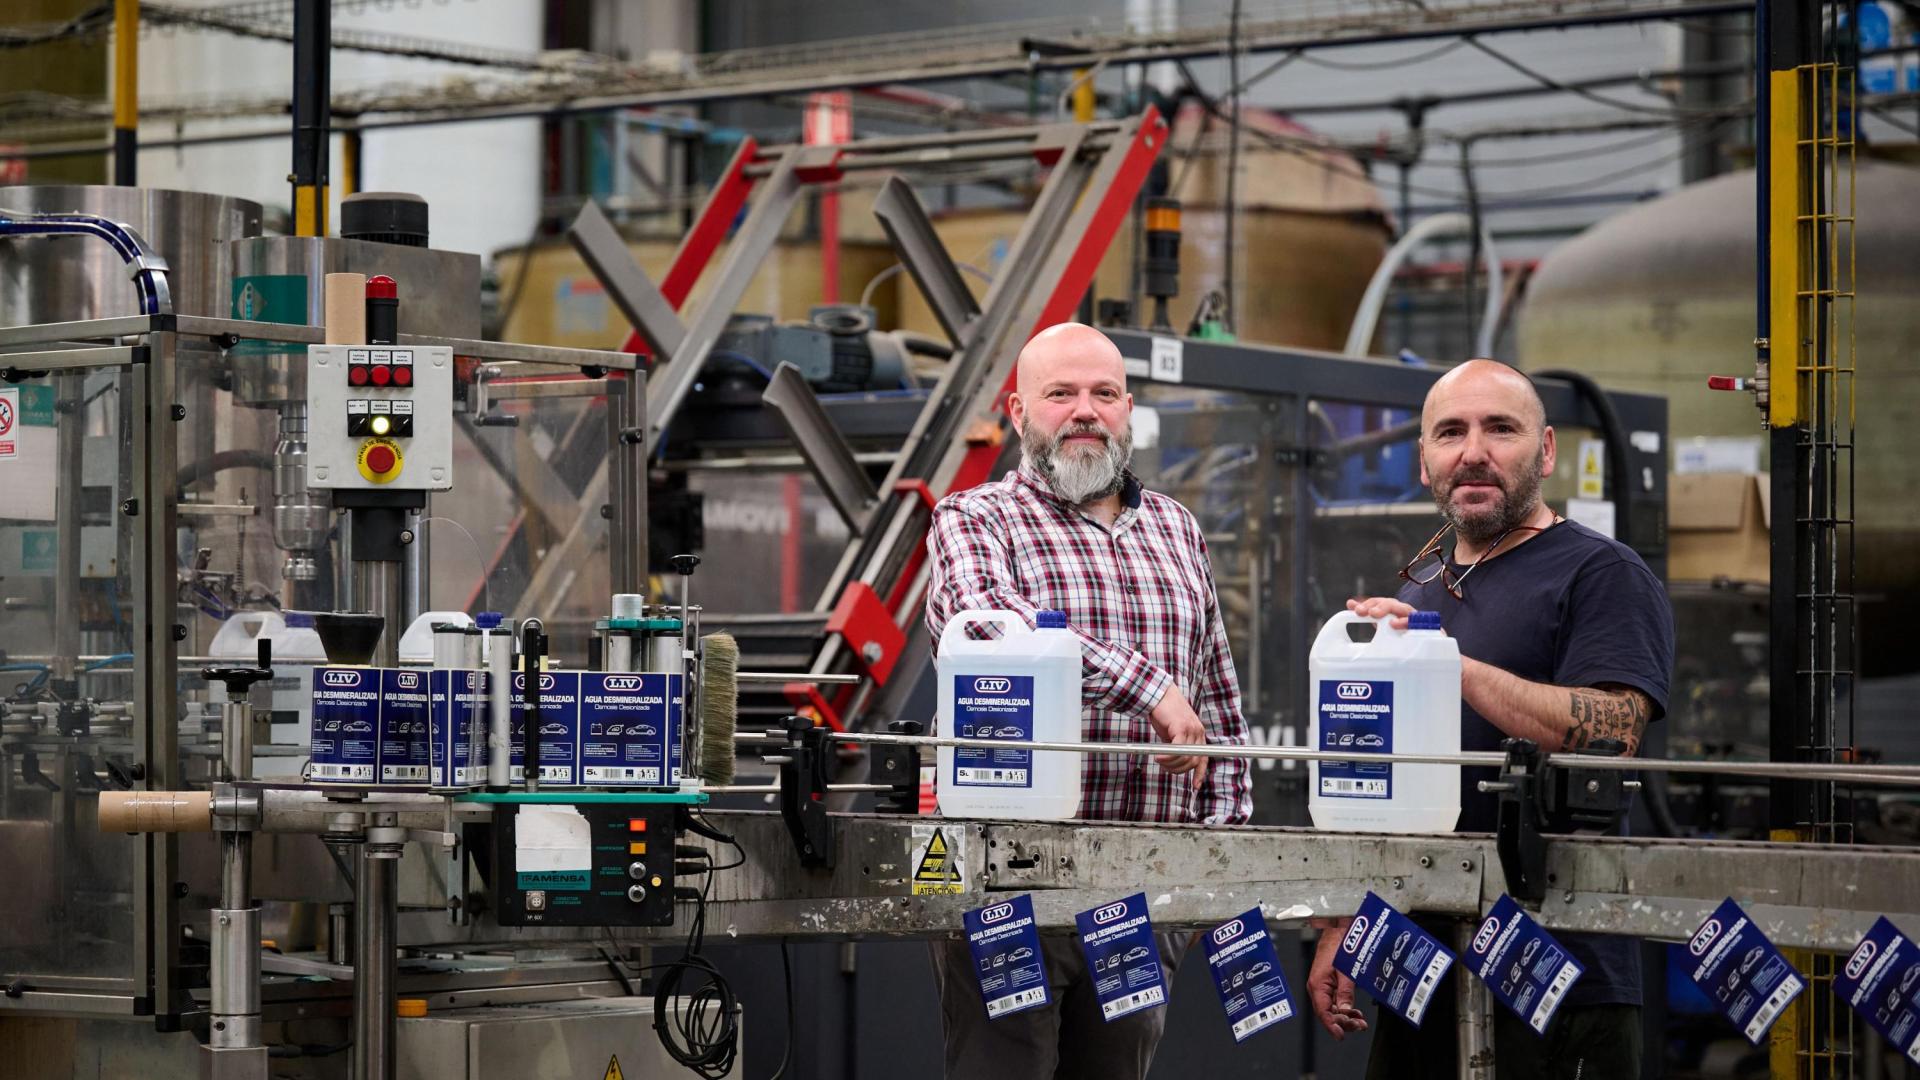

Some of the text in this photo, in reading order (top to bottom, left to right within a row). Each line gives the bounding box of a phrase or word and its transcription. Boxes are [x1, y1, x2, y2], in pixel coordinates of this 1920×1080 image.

[326, 673, 357, 684] LIV
[400, 675, 417, 686] LIV
[608, 678, 638, 689] LIV
[979, 680, 1007, 690] LIV
[313, 691, 378, 700] GUA DESMINERALIZADA
[1341, 685, 1368, 696] LIV
[515, 694, 575, 703] DEERALIZADA
[603, 696, 663, 704] DESMINERALIZADA
[974, 698, 1031, 706] DESMINERALIZADA
[1321, 703, 1390, 713] AGUA DESMINERALIZADA
[985, 905, 1009, 921] LIV
[1097, 905, 1123, 921] LIV
[970, 916, 1033, 942] AGUA DESMINERALIZADA
[1083, 915, 1148, 944] AGUA DESMINERALIZADA
[1216, 922, 1239, 941] LIV
[1346, 919, 1364, 950] LIV
[1475, 920, 1496, 949] LIV
[1692, 922, 1716, 951] LIV
[1219, 929, 1267, 958] DESMINERALIZADA
[1851, 944, 1871, 975] LIV
